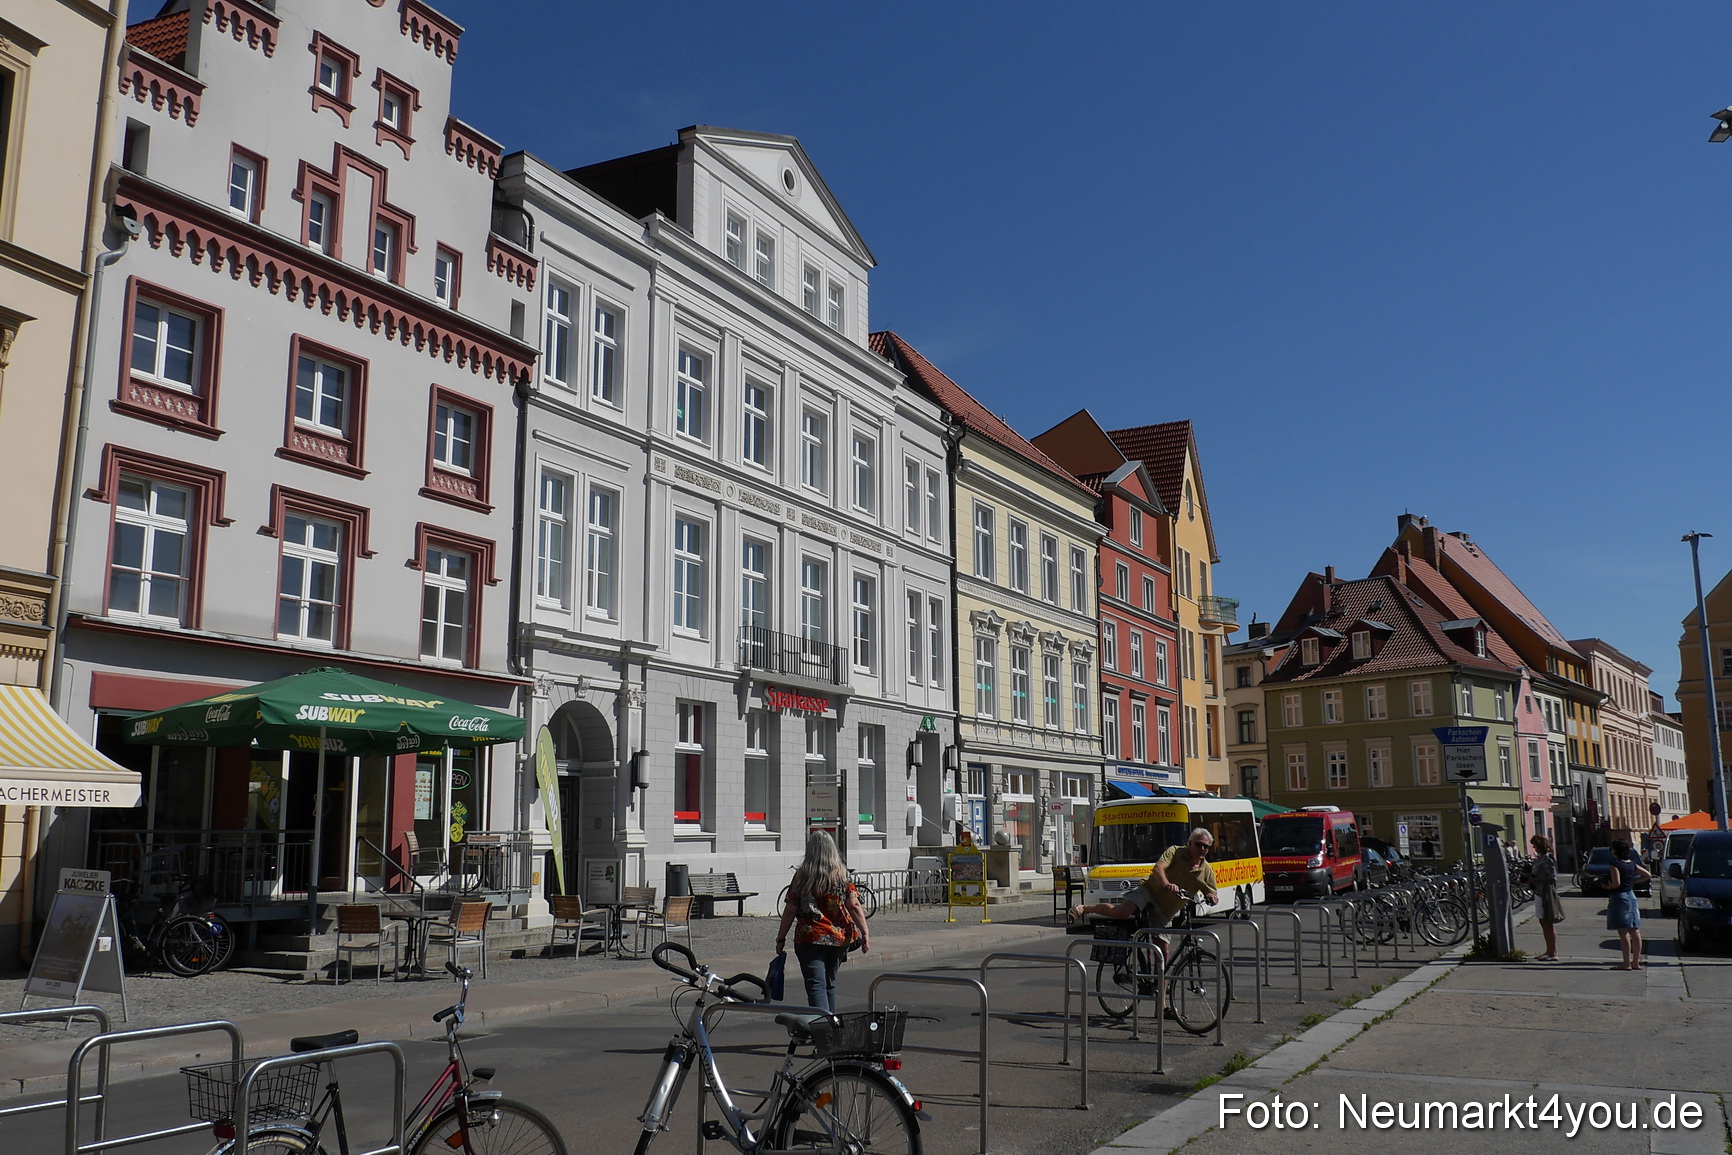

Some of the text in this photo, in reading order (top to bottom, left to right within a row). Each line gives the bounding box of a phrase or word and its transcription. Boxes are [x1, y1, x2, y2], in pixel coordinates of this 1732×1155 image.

[319, 693, 445, 709] SUBWAY
[767, 685, 829, 713] Sparkasse
[295, 705, 367, 724] SUBWAY
[131, 717, 163, 737] SUBWAY
[452, 773, 468, 786] PEN
[1102, 809, 1177, 822] Stadtrundfahrten
[1487, 834, 1495, 846] P
[71, 870, 99, 879] JUWELIER
